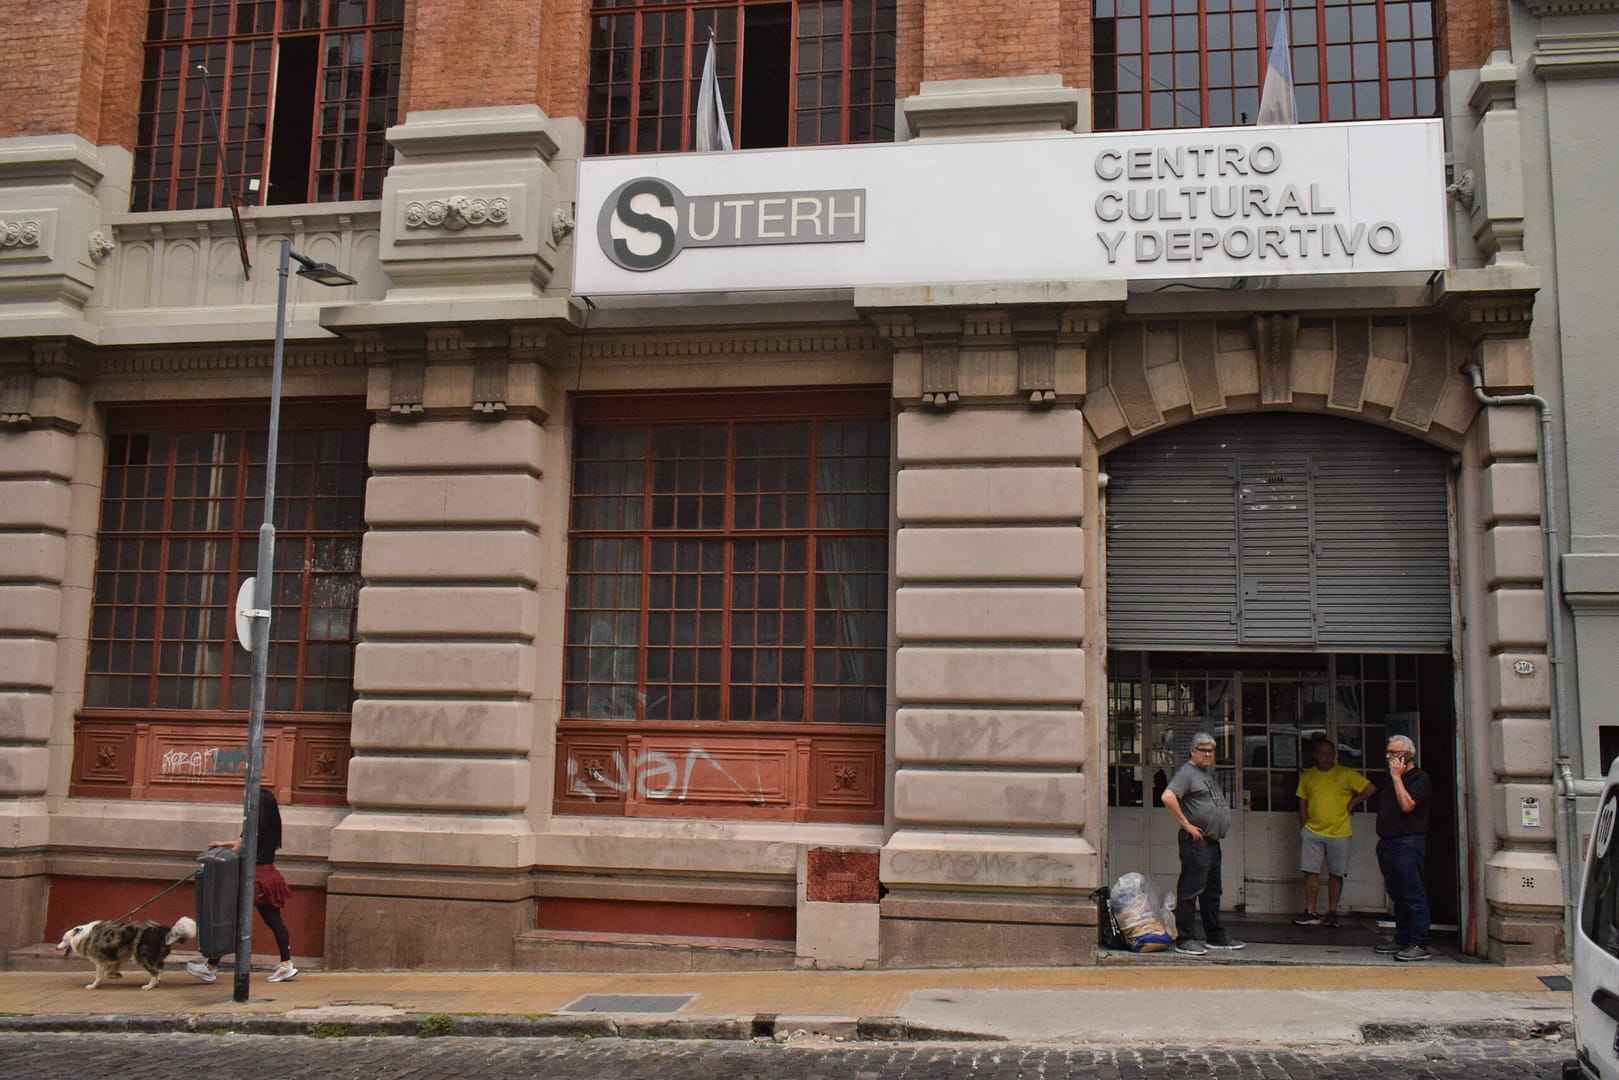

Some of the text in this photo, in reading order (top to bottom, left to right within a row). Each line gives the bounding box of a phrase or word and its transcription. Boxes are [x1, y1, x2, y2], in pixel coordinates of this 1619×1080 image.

[1094, 142, 1282, 180] CENTRO
[1094, 183, 1336, 222] CULTURAL
[613, 179, 861, 269] SUTERH
[1096, 221, 1401, 263] Y DEPORTIVO
